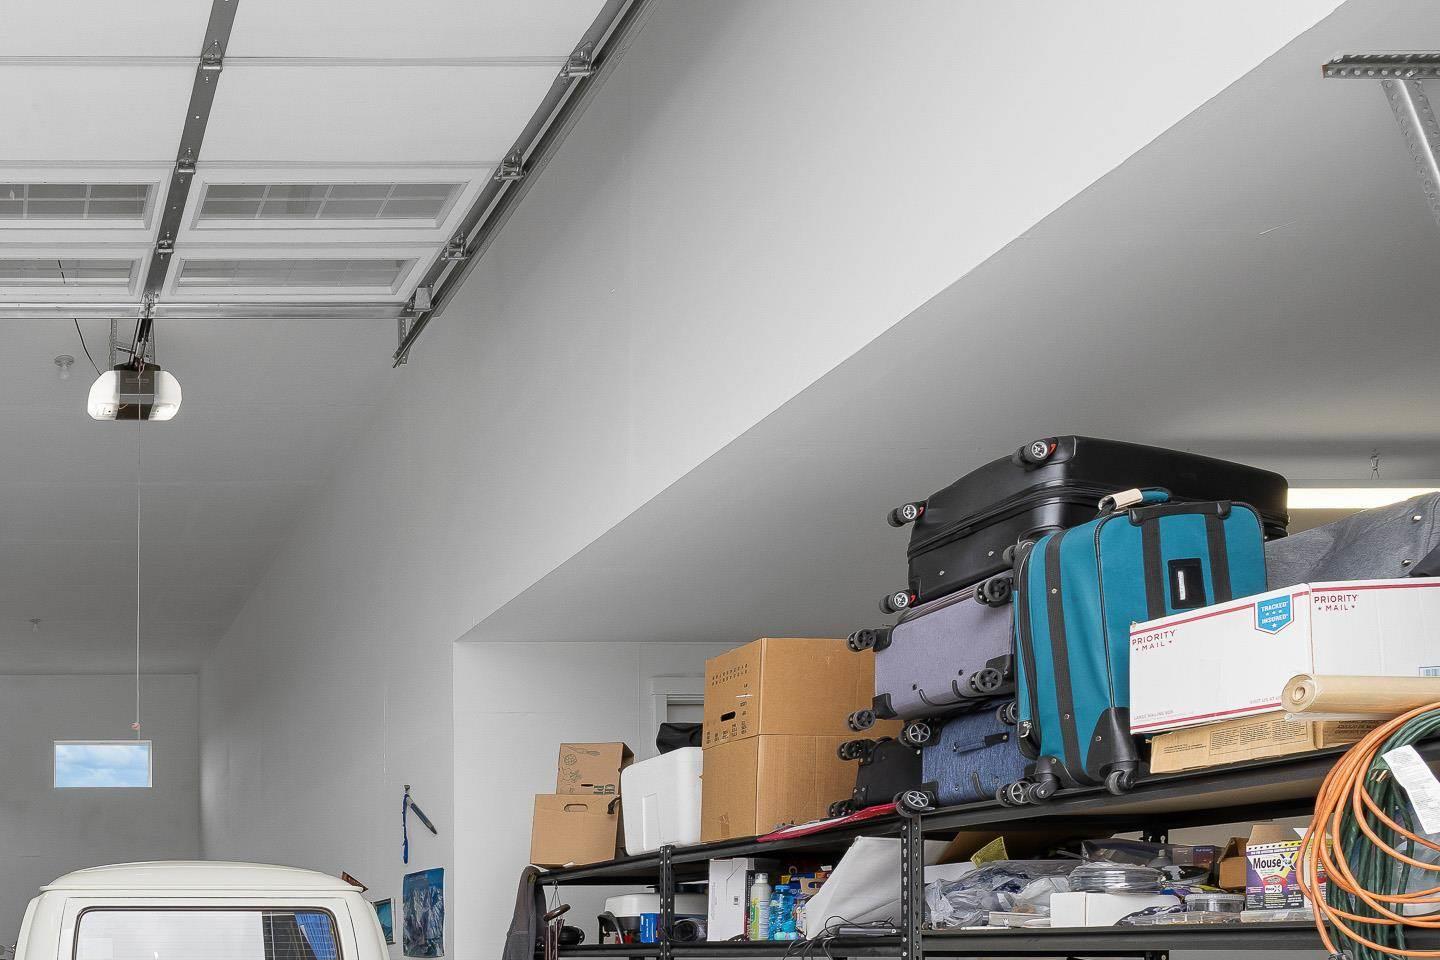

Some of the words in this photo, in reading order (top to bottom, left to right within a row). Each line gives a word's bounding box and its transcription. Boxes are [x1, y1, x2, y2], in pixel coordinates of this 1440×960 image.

[1314, 594, 1357, 604] PRIORITY
[1261, 602, 1287, 612] TRACKED
[1132, 630, 1175, 646] PRIORITY
[1141, 642, 1165, 651] MAIL
